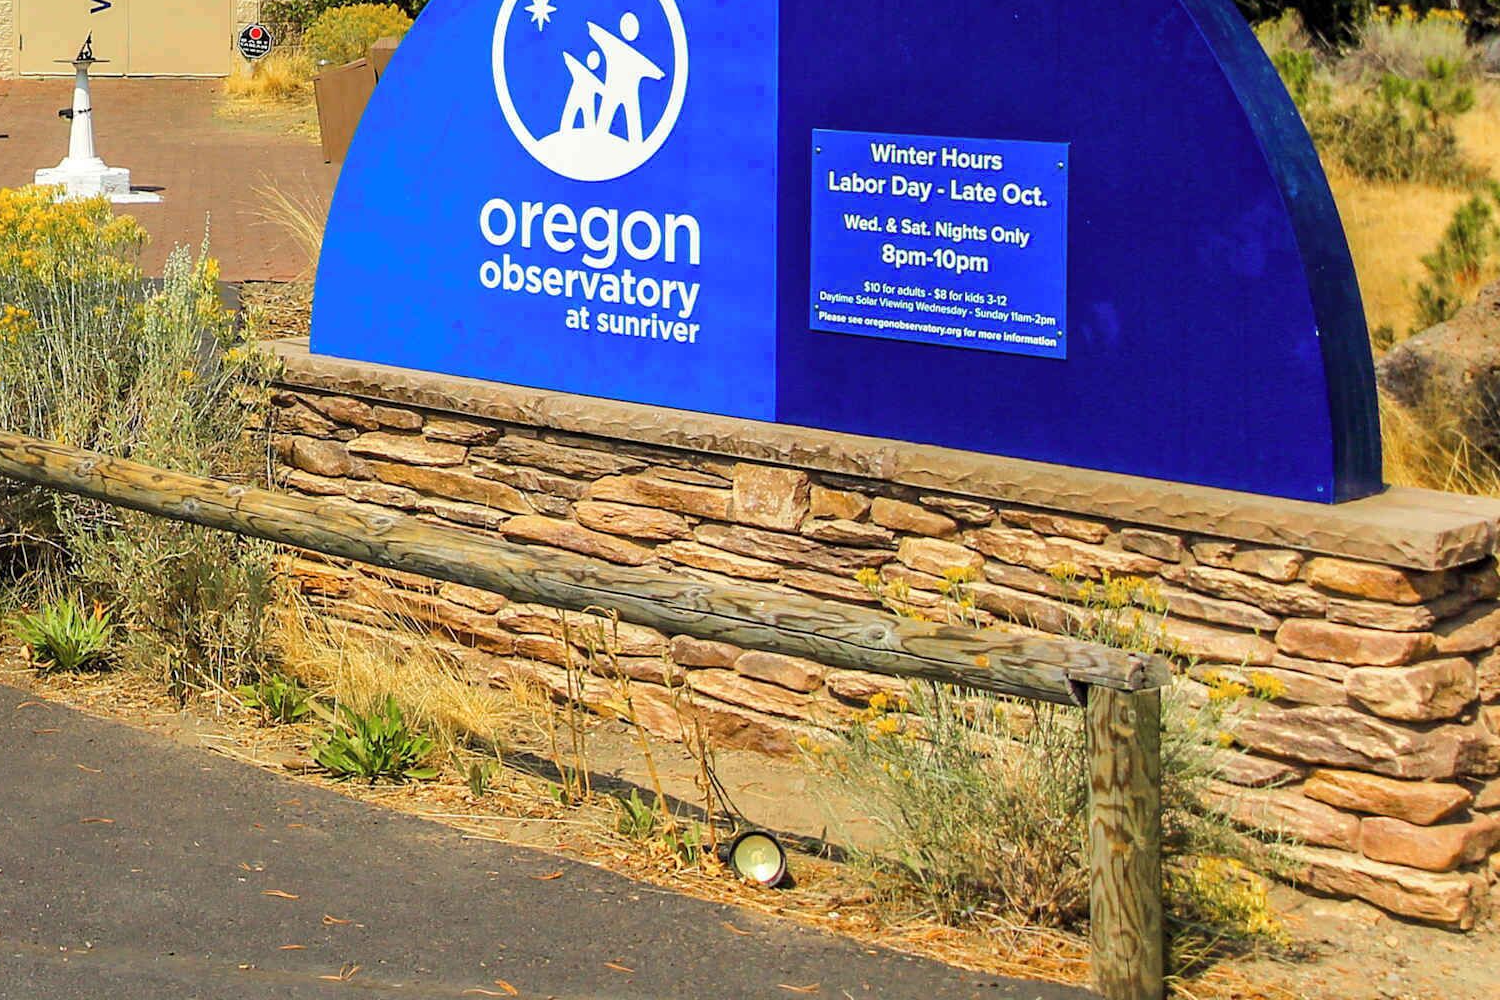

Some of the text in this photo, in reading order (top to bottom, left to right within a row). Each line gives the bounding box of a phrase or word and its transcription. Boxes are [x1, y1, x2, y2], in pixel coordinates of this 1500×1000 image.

[870, 143, 1003, 171] Winter Hours
[828, 170, 886, 194] Labor
[891, 175, 933, 203] Day
[950, 179, 997, 203] Late
[1002, 182, 1048, 207] Oct.
[479, 197, 700, 269] oregon
[843, 213, 1030, 249] Wed. & Sat. Nights Only
[882, 243, 989, 275] 8pm-10pm
[479, 253, 700, 319] observatory
[864, 280, 880, 293] $10
[882, 283, 896, 294] for
[897, 286, 926, 298] adults
[934, 288, 947, 300] $8
[948, 289, 963, 301] for
[964, 291, 985, 304] kids
[986, 294, 1008, 307] 3-12
[565, 306, 700, 344] at sunriver
[819, 290, 854, 304] Daytime
[855, 294, 877, 306] Solar
[879, 298, 914, 312] Viewing
[915, 301, 968, 318] Wednesday
[974, 307, 1009, 322] Sunday
[1011, 311, 1056, 327] 11am-2pm
[818, 310, 1057, 347] Please see oregonobservatory.org for more information
